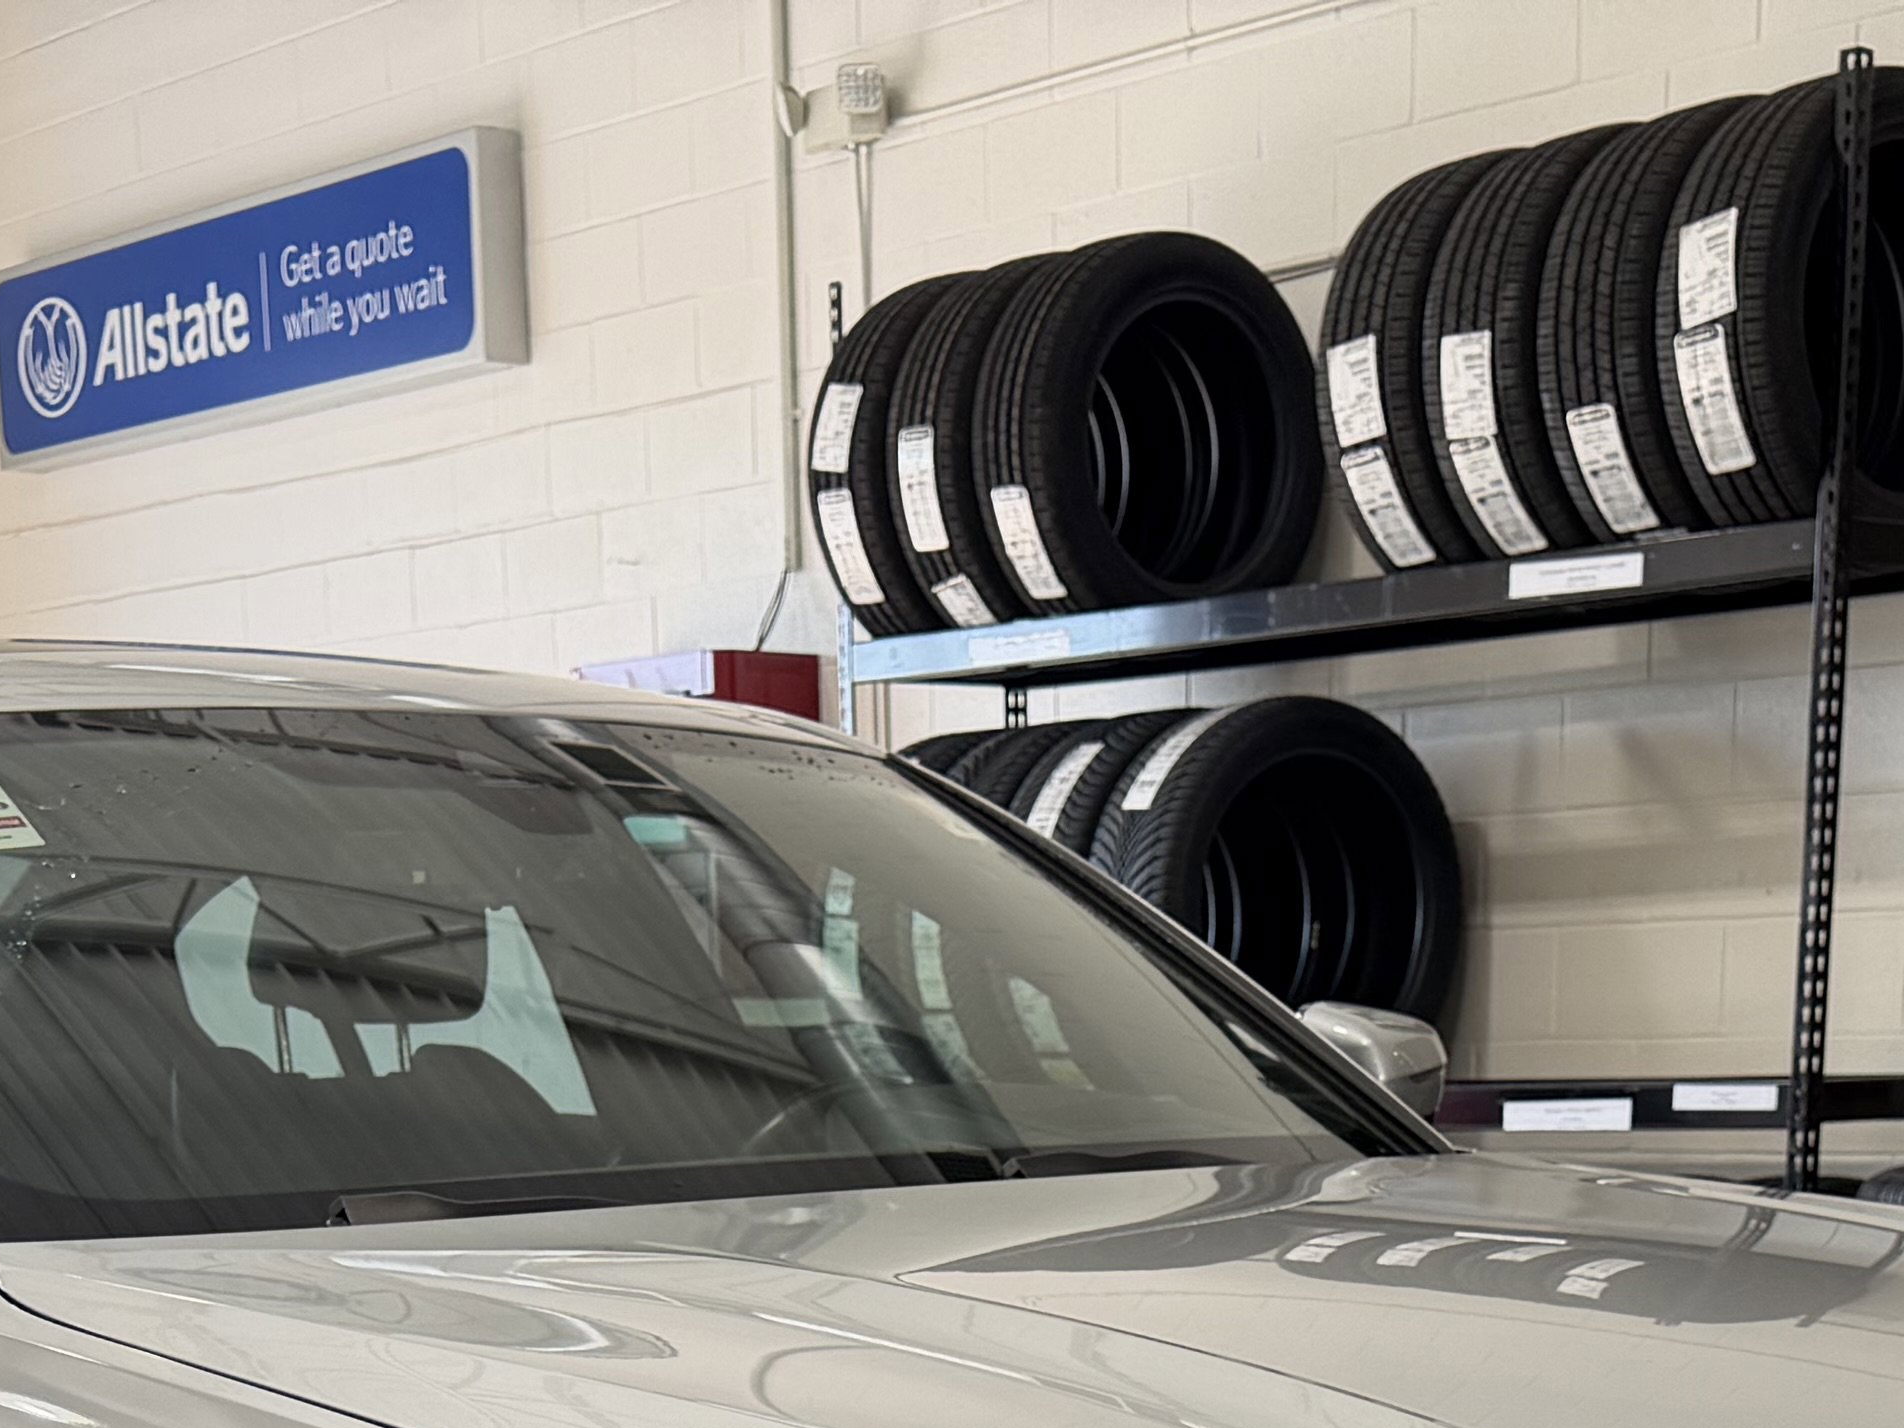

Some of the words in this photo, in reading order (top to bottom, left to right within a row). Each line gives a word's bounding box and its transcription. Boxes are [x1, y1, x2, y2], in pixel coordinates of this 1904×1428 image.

[279, 241, 323, 287] Get
[325, 245, 342, 274] a
[344, 220, 414, 278] quote
[92, 281, 251, 387] Allstate
[282, 292, 345, 342] while
[346, 284, 391, 336] you
[395, 264, 448, 315] wait
